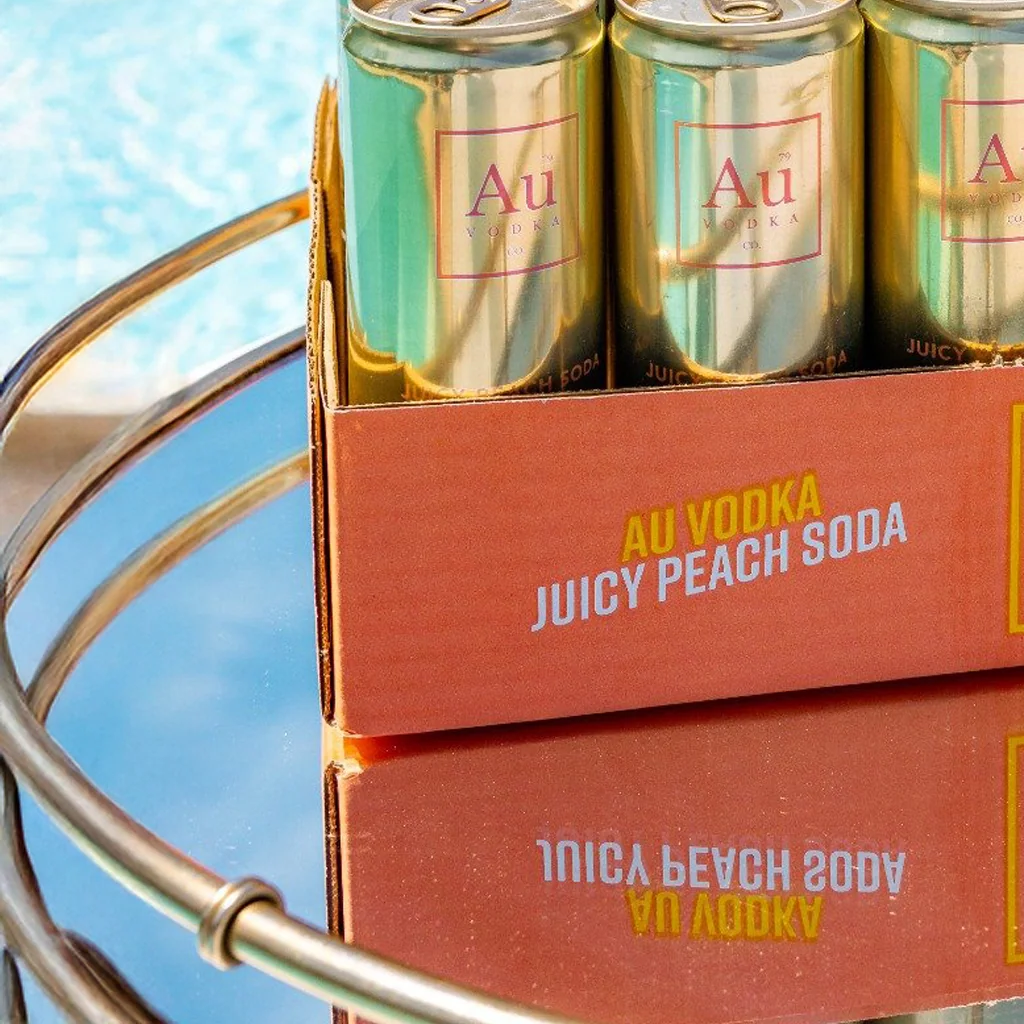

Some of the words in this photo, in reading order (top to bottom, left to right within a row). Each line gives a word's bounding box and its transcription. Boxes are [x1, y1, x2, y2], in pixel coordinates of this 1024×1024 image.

[465, 164, 557, 216] Au
[702, 157, 796, 208] Au
[466, 216, 560, 238] VODKA
[703, 214, 799, 230] VODKA
[561, 353, 600, 388] SODA
[906, 338, 966, 362] JUICY
[620, 507, 676, 562] AU
[686, 473, 822, 546] VODKA
[531, 562, 646, 633] JUICY
[658, 529, 789, 602] PEACH
[802, 501, 908, 566] SODA
